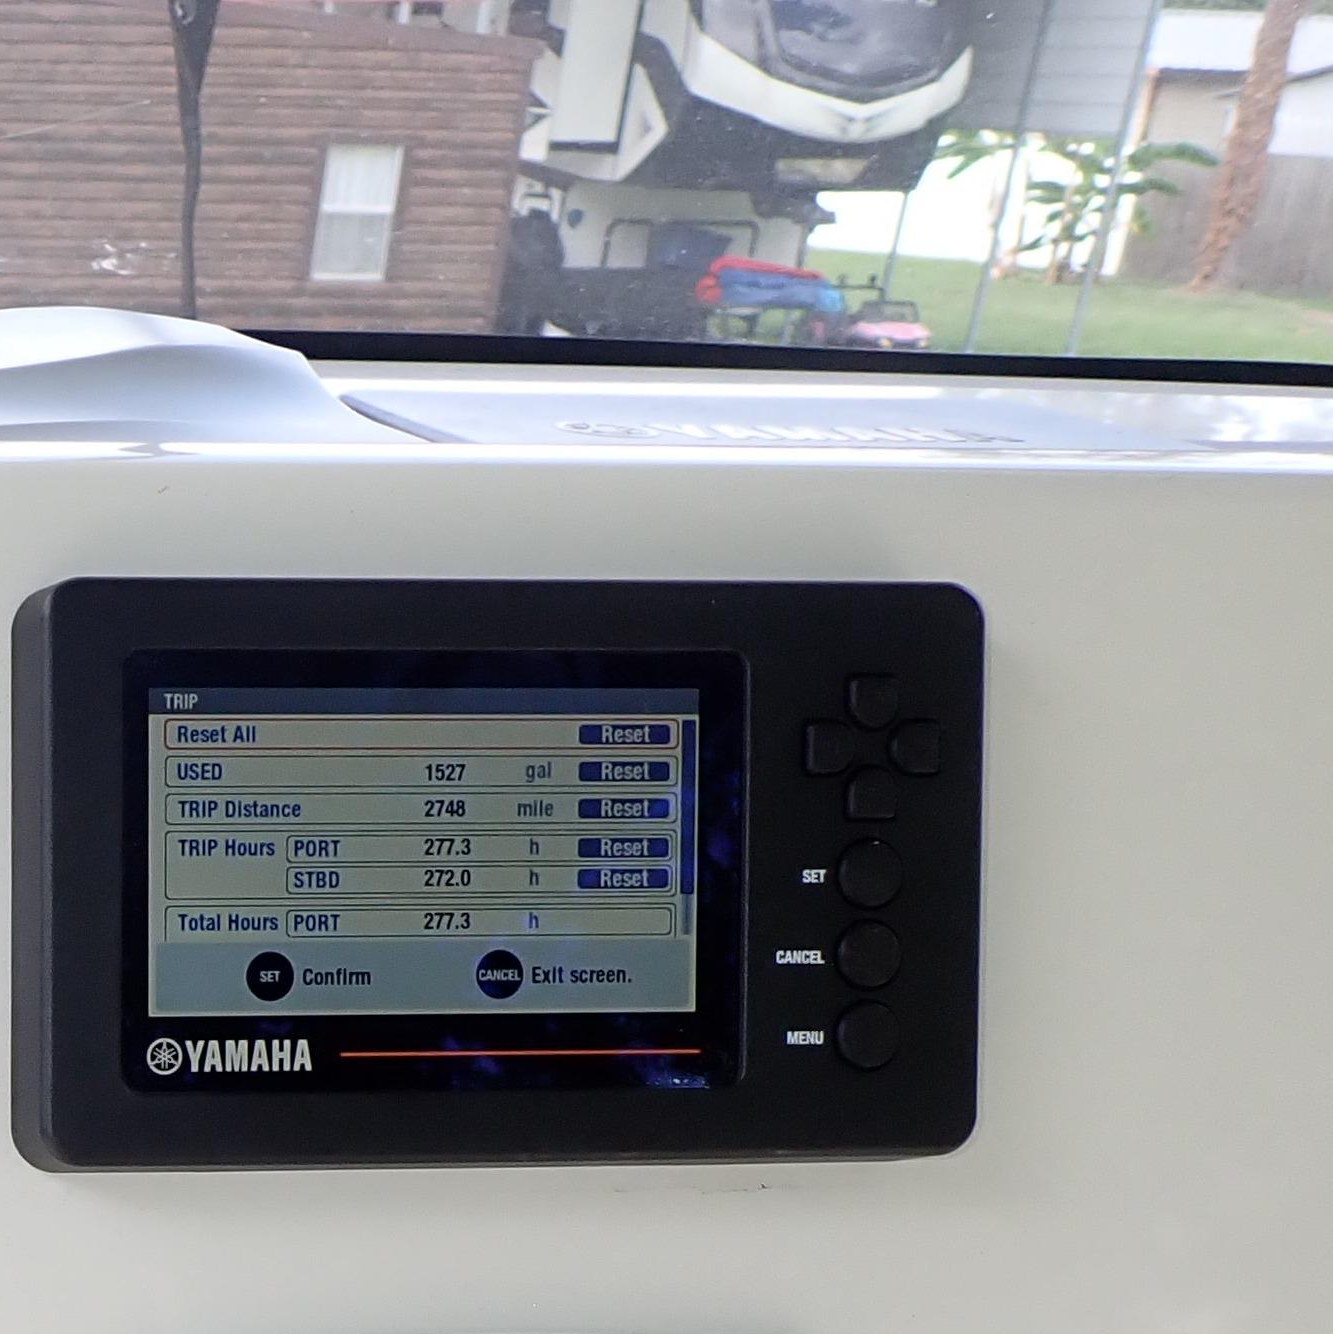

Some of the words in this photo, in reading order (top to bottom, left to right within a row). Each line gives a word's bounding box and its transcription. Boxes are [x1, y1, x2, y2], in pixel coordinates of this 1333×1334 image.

[164, 693, 198, 710] TRIP
[177, 725, 227, 744] Reset
[232, 725, 256, 744] All
[601, 725, 651, 744] Reset
[177, 763, 223, 781] USED
[425, 763, 466, 782] 1527
[525, 761, 552, 782] gal
[601, 762, 651, 781] Reset
[178, 800, 217, 818] TRIP
[225, 800, 301, 818] Distance
[424, 800, 466, 818] 2748
[517, 799, 554, 818] mile
[601, 799, 651, 818] Reset
[178, 839, 217, 857] TRIP
[225, 839, 276, 857] Hours
[294, 839, 341, 857] PORT
[424, 838, 472, 857] 277.3
[529, 838, 540, 856] h
[600, 838, 651, 857] Reset
[294, 871, 340, 889] STBD
[424, 870, 472, 888] 272.0
[529, 869, 540, 887] h
[600, 869, 650, 888] Reset
[802, 869, 827, 884] SET
[178, 914, 221, 932] Total
[228, 914, 279, 932] Hours
[294, 914, 341, 932] PORT
[424, 912, 471, 931] 277.3
[529, 912, 539, 930] h
[776, 950, 826, 965] CANCEL
[259, 970, 281, 983] SET
[302, 968, 372, 986] Confirm
[478, 968, 522, 982] CANCEL
[531, 967, 564, 984] Exit
[570, 967, 633, 984] screen.
[787, 1031, 825, 1046] MENU
[186, 1038, 313, 1073] YAMAHA
